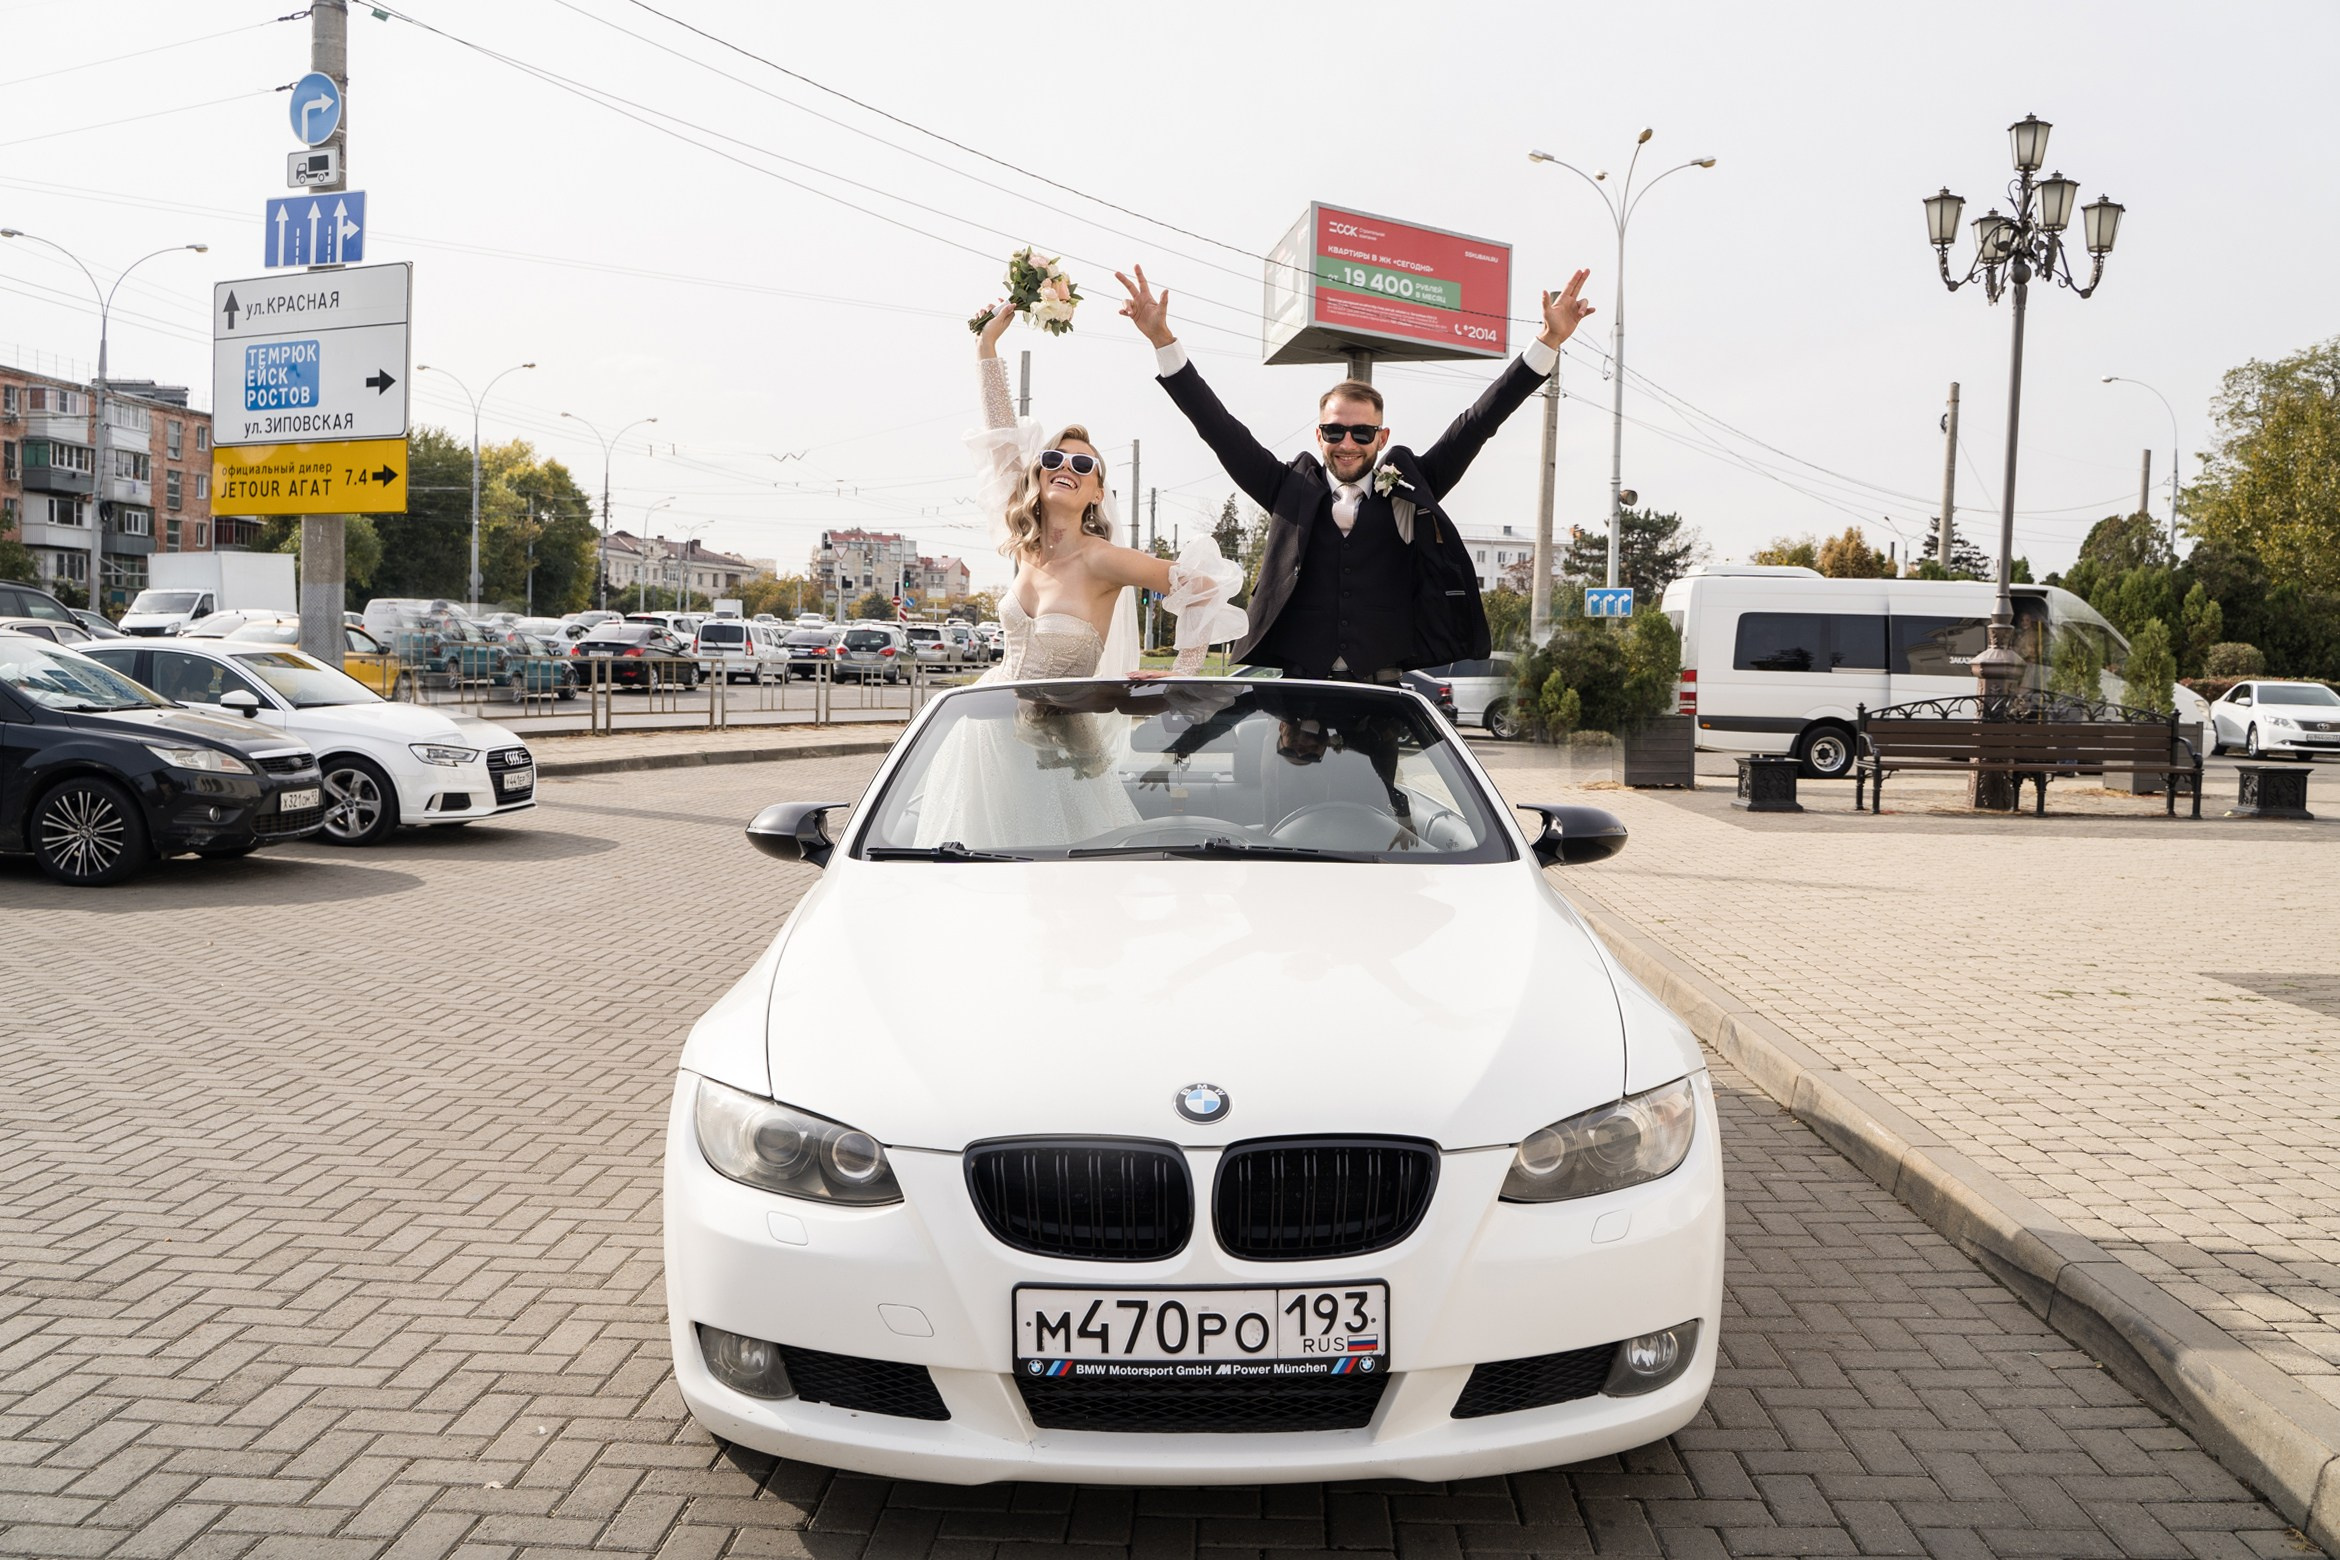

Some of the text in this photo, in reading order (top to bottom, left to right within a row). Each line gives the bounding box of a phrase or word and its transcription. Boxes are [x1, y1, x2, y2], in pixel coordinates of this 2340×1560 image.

[1328, 245, 1434, 273] КВАРТИРЫ В ЖК «СЕГОДНЯ»
[1344, 267, 1366, 287] 19
[1370, 273, 1413, 297] 400
[1415, 282, 1443, 293] РУБЛЕЙ
[1422, 293, 1446, 304] МЕСЯЦ
[248, 344, 317, 366] ТЕМРЮК
[247, 364, 288, 387] ЕЙСК
[247, 386, 310, 407] РОСТОВ
[222, 462, 332, 478] официальный дилер
[345, 469, 368, 486] 7.4
[221, 479, 332, 498] JETOUR АГАТ
[1180, 1084, 1226, 1096] BMW
[1284, 1291, 1369, 1336] 193
[1303, 1337, 1345, 1353] RUS
[1076, 1364, 1106, 1375] BMW
[1109, 1365, 1173, 1377] Motorsport
[1176, 1365, 1212, 1375] GmbH
[1274, 1363, 1328, 1374] München
